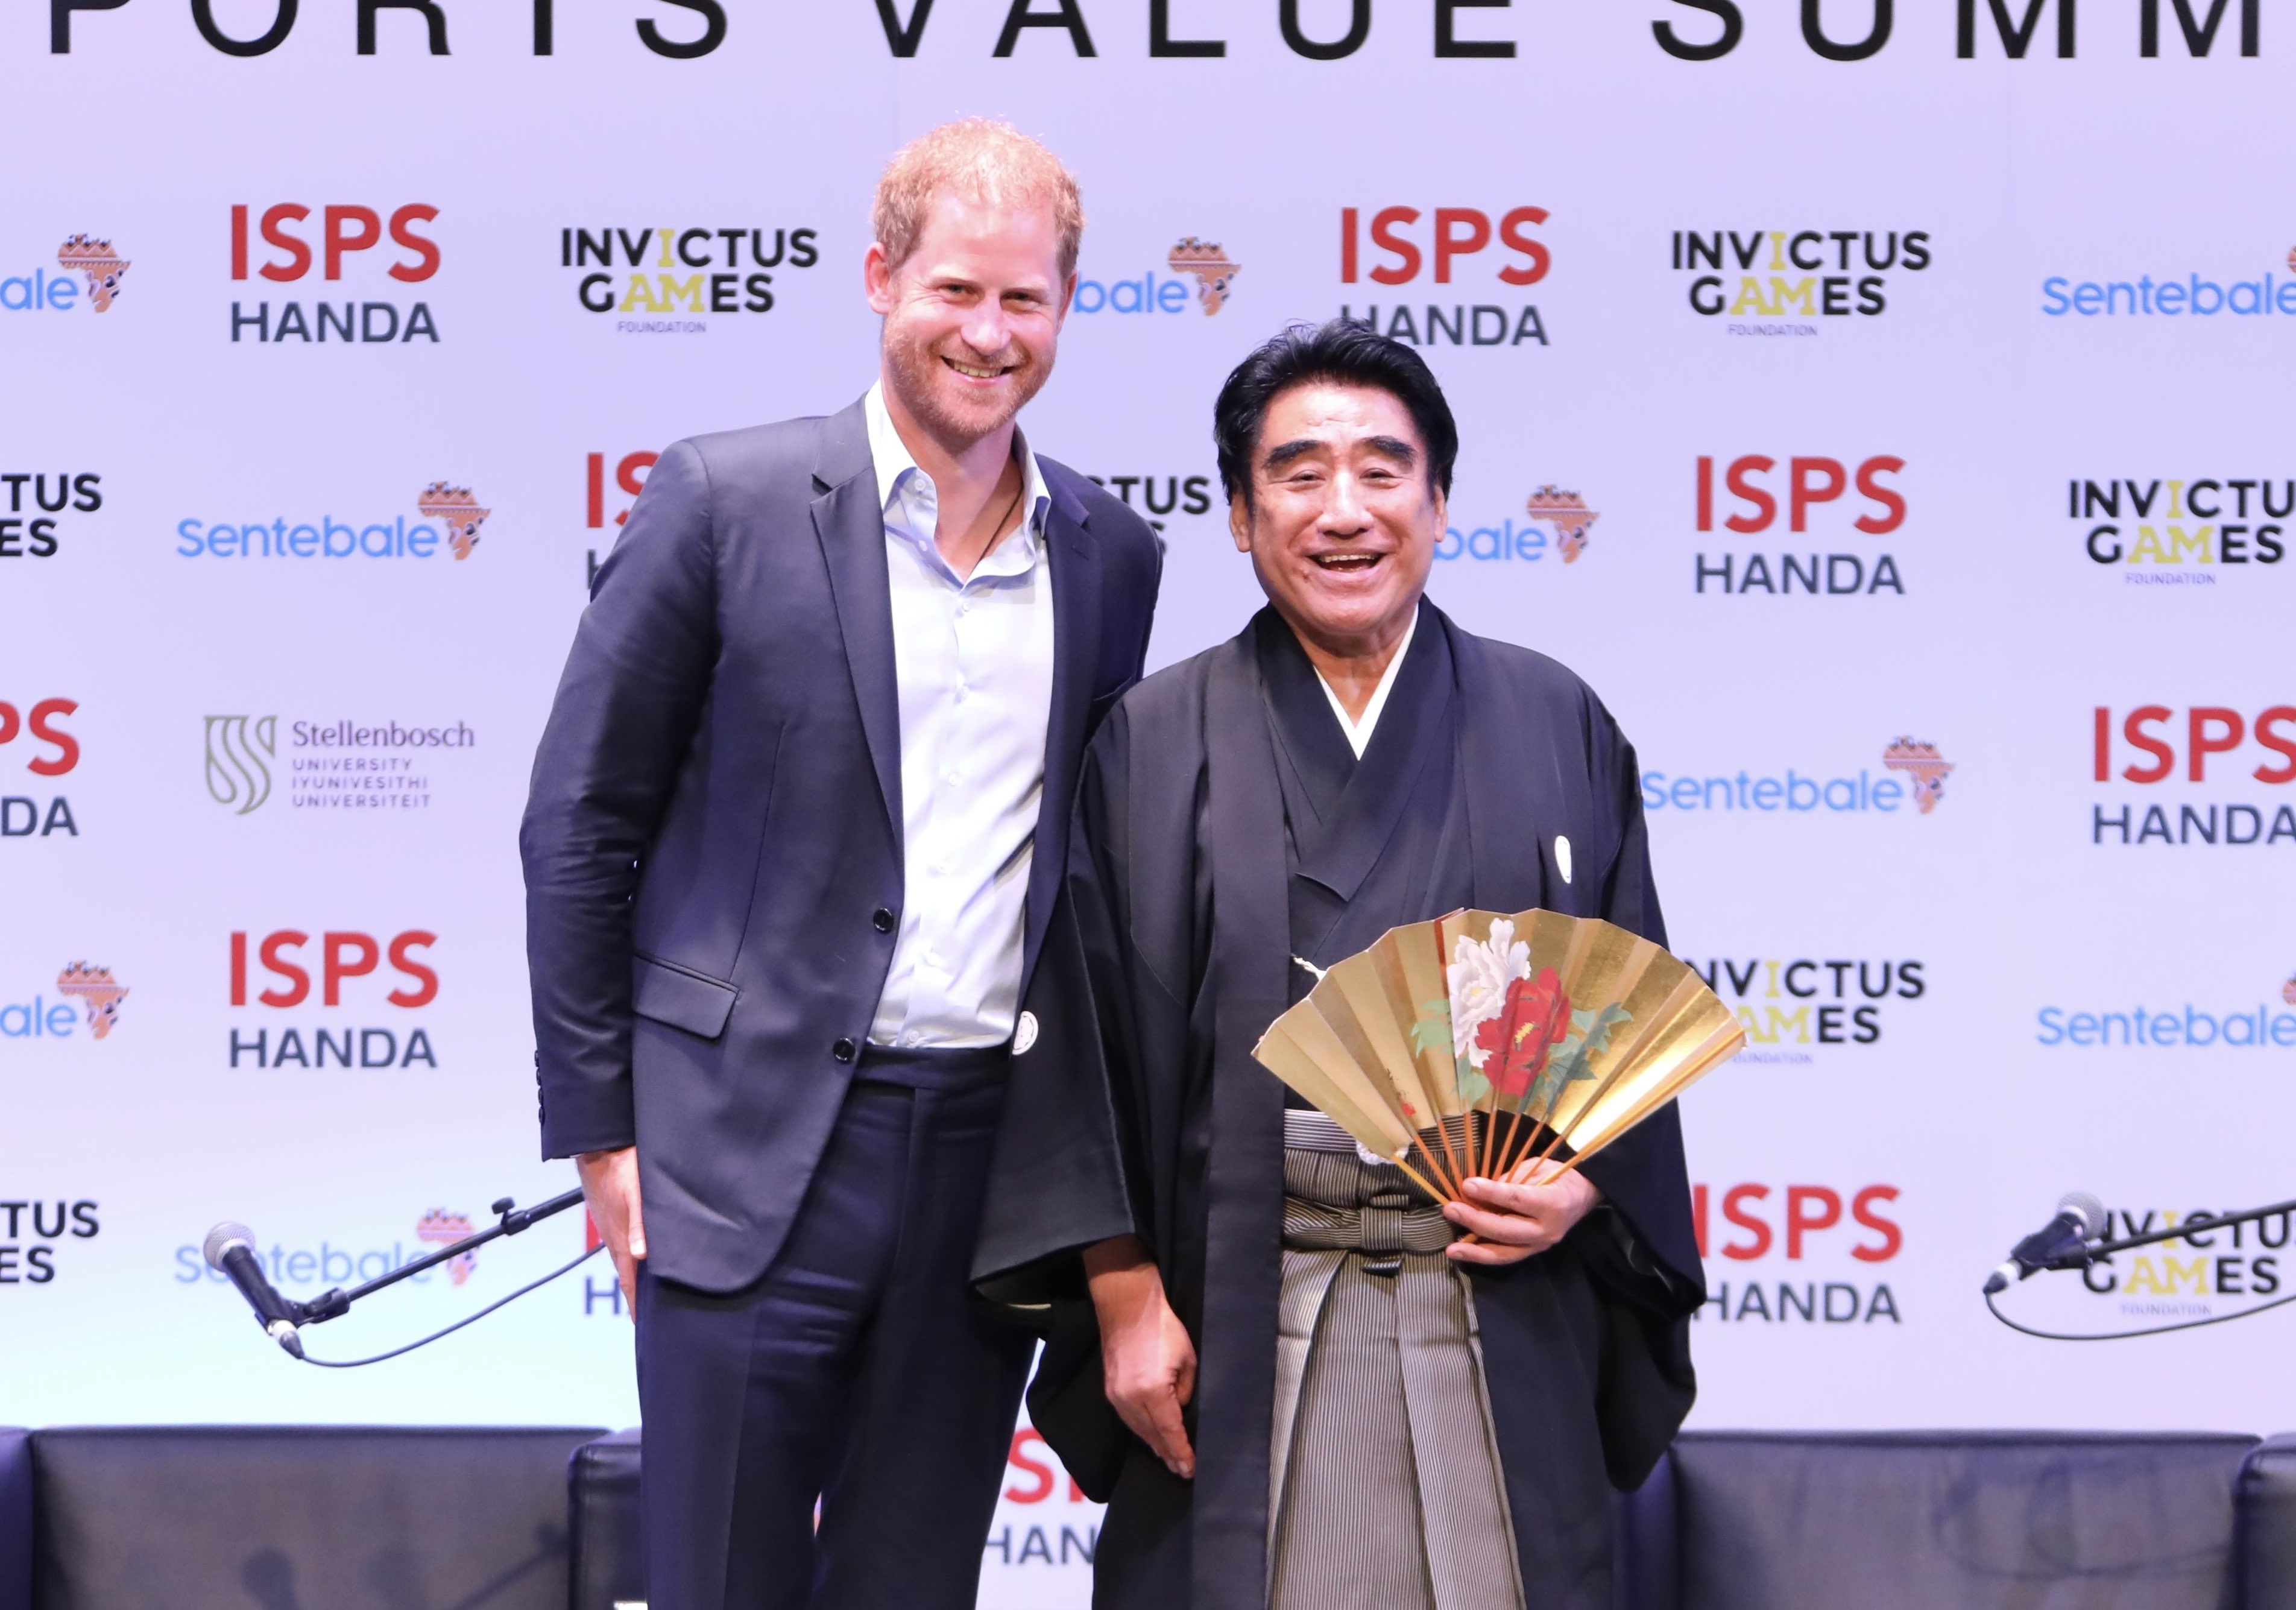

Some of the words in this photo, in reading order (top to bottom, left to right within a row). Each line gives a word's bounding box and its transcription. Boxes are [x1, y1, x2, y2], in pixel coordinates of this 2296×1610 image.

[232, 203, 440, 283] ISPS
[563, 229, 818, 268] INVICTUS
[1342, 206, 1550, 286] ISPS
[1673, 231, 1930, 271] INVICTUS
[579, 273, 774, 312] GAMES
[1689, 276, 1885, 315] GAMES
[2042, 273, 2296, 315] Sentebale
[232, 302, 440, 343] HANDA
[617, 321, 706, 333] FOUNDATION
[1728, 324, 1817, 336] FOUNDATION
[1697, 455, 1906, 534] ISPS
[177, 516, 438, 558] Sentebale
[2087, 525, 2283, 564] GAMES
[1697, 554, 1904, 595] HANDA
[2126, 573, 2215, 584] FOUNDATION
[293, 721, 474, 747] Stellenbosch
[2095, 706, 2296, 784] ISPS
[293, 758, 411, 771] UNIVERSITY
[293, 777, 426, 789] IYUNIVESITHI
[292, 795, 430, 807] UNIVERSITEIT
[1641, 769, 1903, 810] Sentebale
[2094, 805, 2296, 844] HANDA
[230, 930, 438, 1008] ISPS
[1684, 960, 1925, 998] NVICTUS
[1738, 1005, 1881, 1044] AMES
[2037, 1005, 2296, 1046] Sentebale
[230, 1029, 437, 1068] HANDA
[1692, 1183, 1903, 1261] ISPS
[174, 1242, 435, 1283] Sntebale
[2083, 1255, 2279, 1294] GAMES
[1692, 1282, 1902, 1323] HANDA
[2121, 1303, 2212, 1315] FOUNDATION
